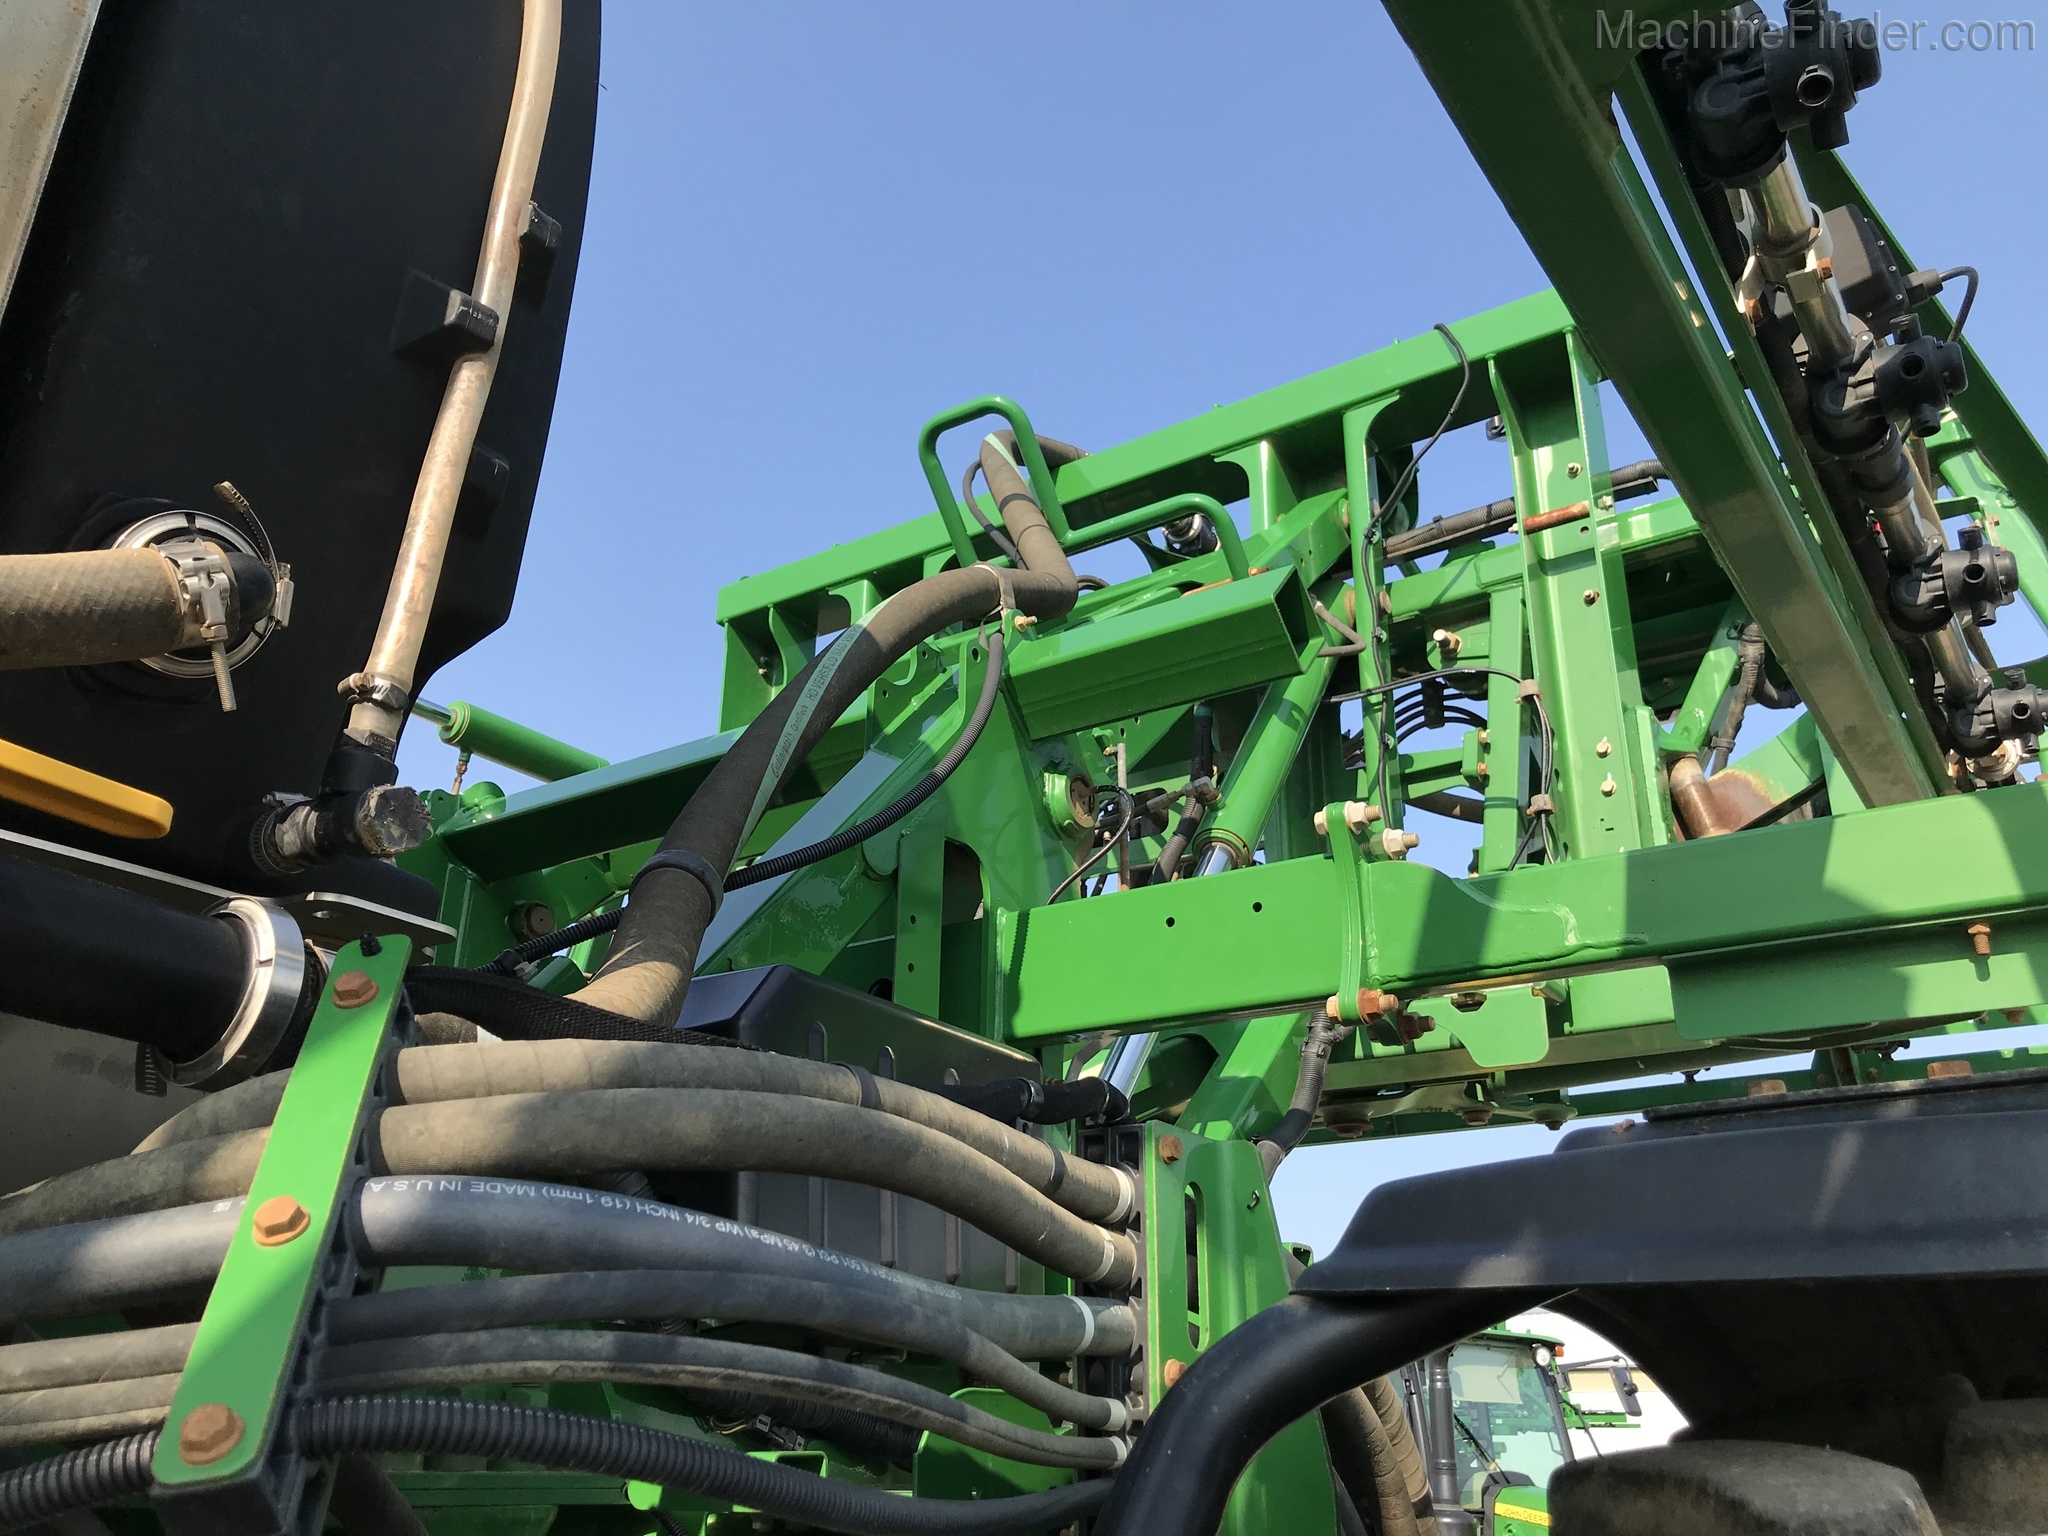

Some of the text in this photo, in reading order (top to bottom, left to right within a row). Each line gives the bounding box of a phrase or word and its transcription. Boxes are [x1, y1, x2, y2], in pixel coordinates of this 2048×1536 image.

[771, 735, 793, 778] Continental
[790, 704, 809, 732] ContiTech
[805, 687, 819, 702] HD
[364, 1179, 433, 1193] U.S.A.
[440, 1181, 462, 1192] IN
[470, 1181, 536, 1197] MADE
[542, 1186, 631, 1210] (19.1mm)
[636, 1202, 680, 1222] INCH
[685, 1212, 711, 1228] 3/4
[715, 1221, 744, 1237] WP
[1502, 1507, 1522, 1518] JOHN
